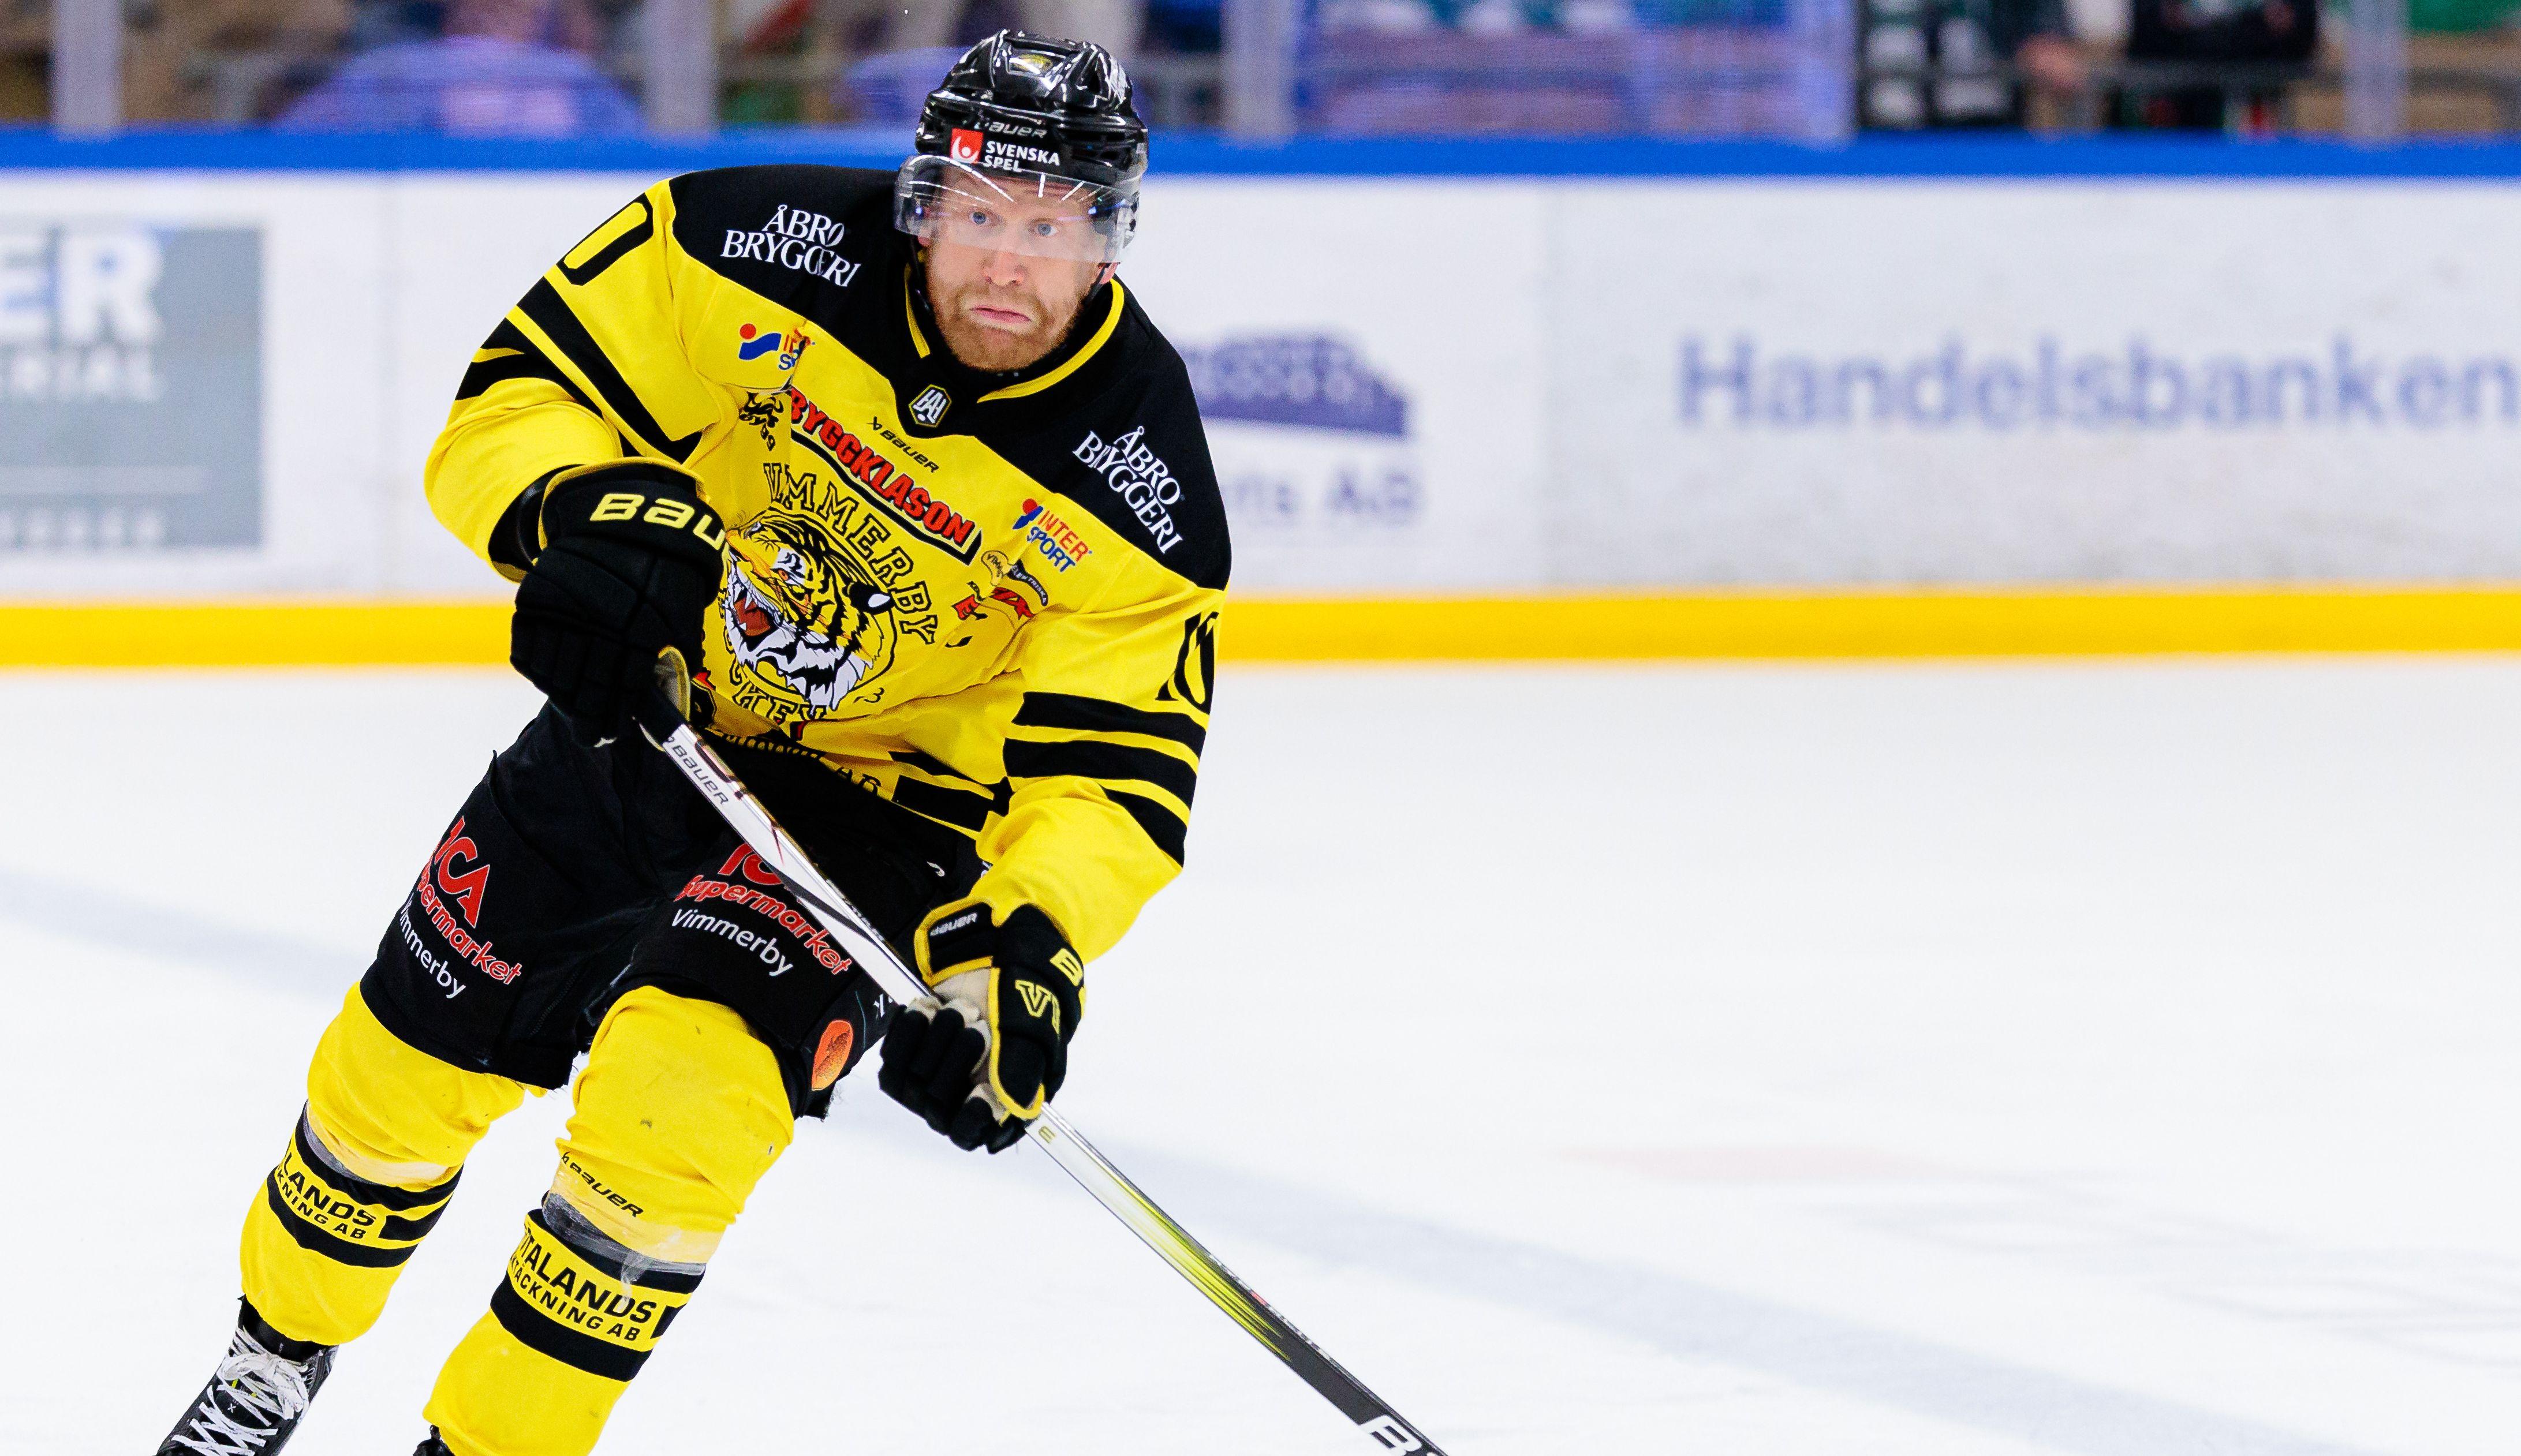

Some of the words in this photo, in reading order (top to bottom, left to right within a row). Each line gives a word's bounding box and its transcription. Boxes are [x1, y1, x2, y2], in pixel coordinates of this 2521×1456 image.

[983, 154, 1024, 173] SPEL
[984, 121, 1048, 139] AUER
[985, 140, 1060, 167] SVENSKA
[761, 204, 845, 248] ÅBRO
[1676, 335, 2519, 429] Handelsbanken
[790, 385, 976, 547] BYGGKLASON
[1072, 431, 1185, 555] BRYGGERI
[1114, 425, 1182, 507] ÅBRO
[763, 462, 939, 645] VMMERBY
[1026, 526, 1077, 575] SPORT
[1038, 510, 1090, 563] INTER
[671, 744, 729, 805] BAUER
[434, 815, 491, 929] ICA
[718, 843, 783, 885] IC
[671, 908, 794, 977] Vimmerby
[673, 874, 853, 975] Supermarket
[333, 1223, 367, 1240] AB
[512, 1258, 604, 1330] TÄCKNING
[606, 1323, 641, 1342] AB
[520, 1227, 658, 1324] TALANDS
